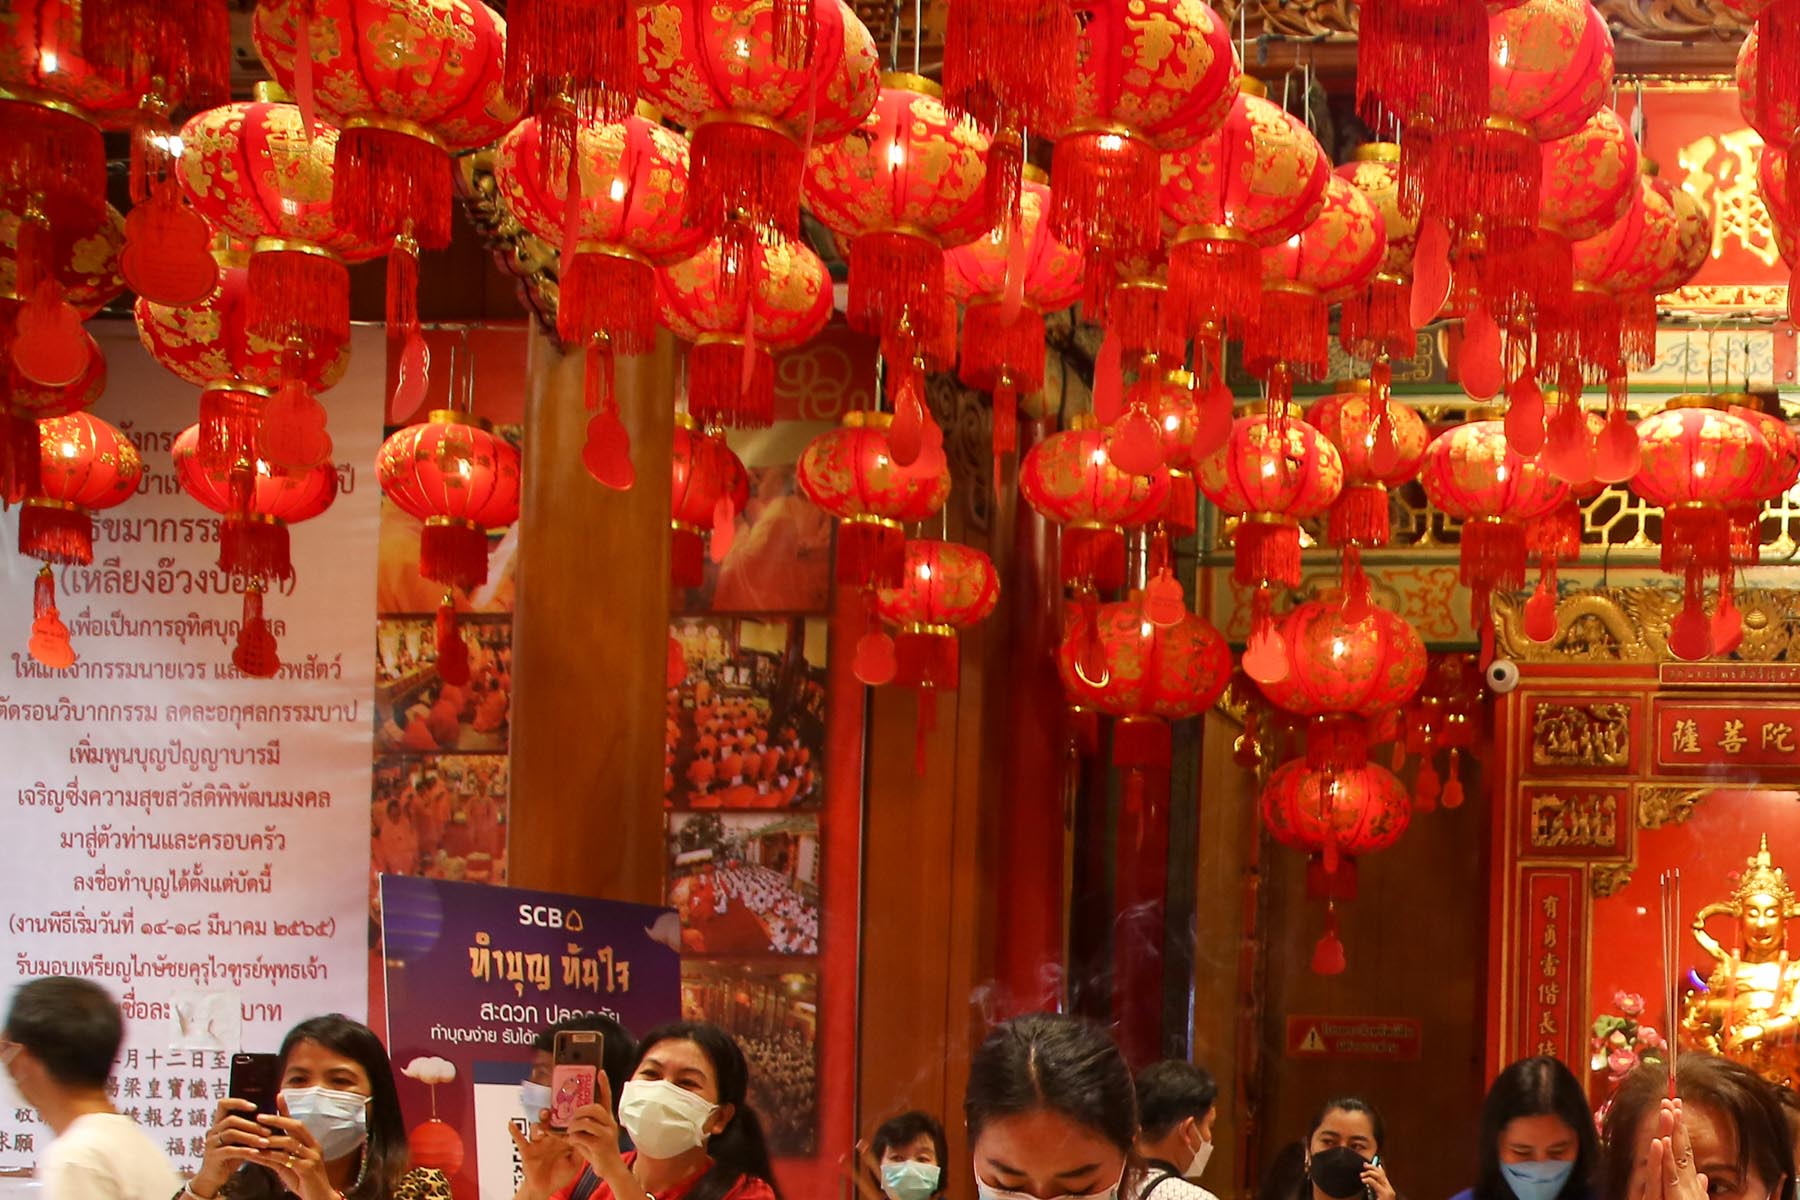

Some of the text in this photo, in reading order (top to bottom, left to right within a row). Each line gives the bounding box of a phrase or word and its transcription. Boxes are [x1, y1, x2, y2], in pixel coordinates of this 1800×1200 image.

[165, 698, 358, 730] ลดละอกุศลกรรมบาป
[69, 733, 281, 773] เพิ่มพูนบุญปัญญาบารมี
[60, 823, 286, 858] มาสู่ตัวท่านและครอบครัว
[73, 862, 272, 899] ลงชื่อทำบุญได้ตั้งแต่บัดนี้
[8, 906, 336, 939] (งานพิธีเริ่มวันที่ ๑๔-๑๘ มีนาคม ๒๕๖๕)
[518, 903, 563, 928] SCB
[468, 931, 630, 997] ทำบุญ ทันใจ
[241, 1002, 282, 1021] บาท
[479, 1002, 539, 1024] สะดวก
[430, 1023, 497, 1046] ทำบุญง่าย
